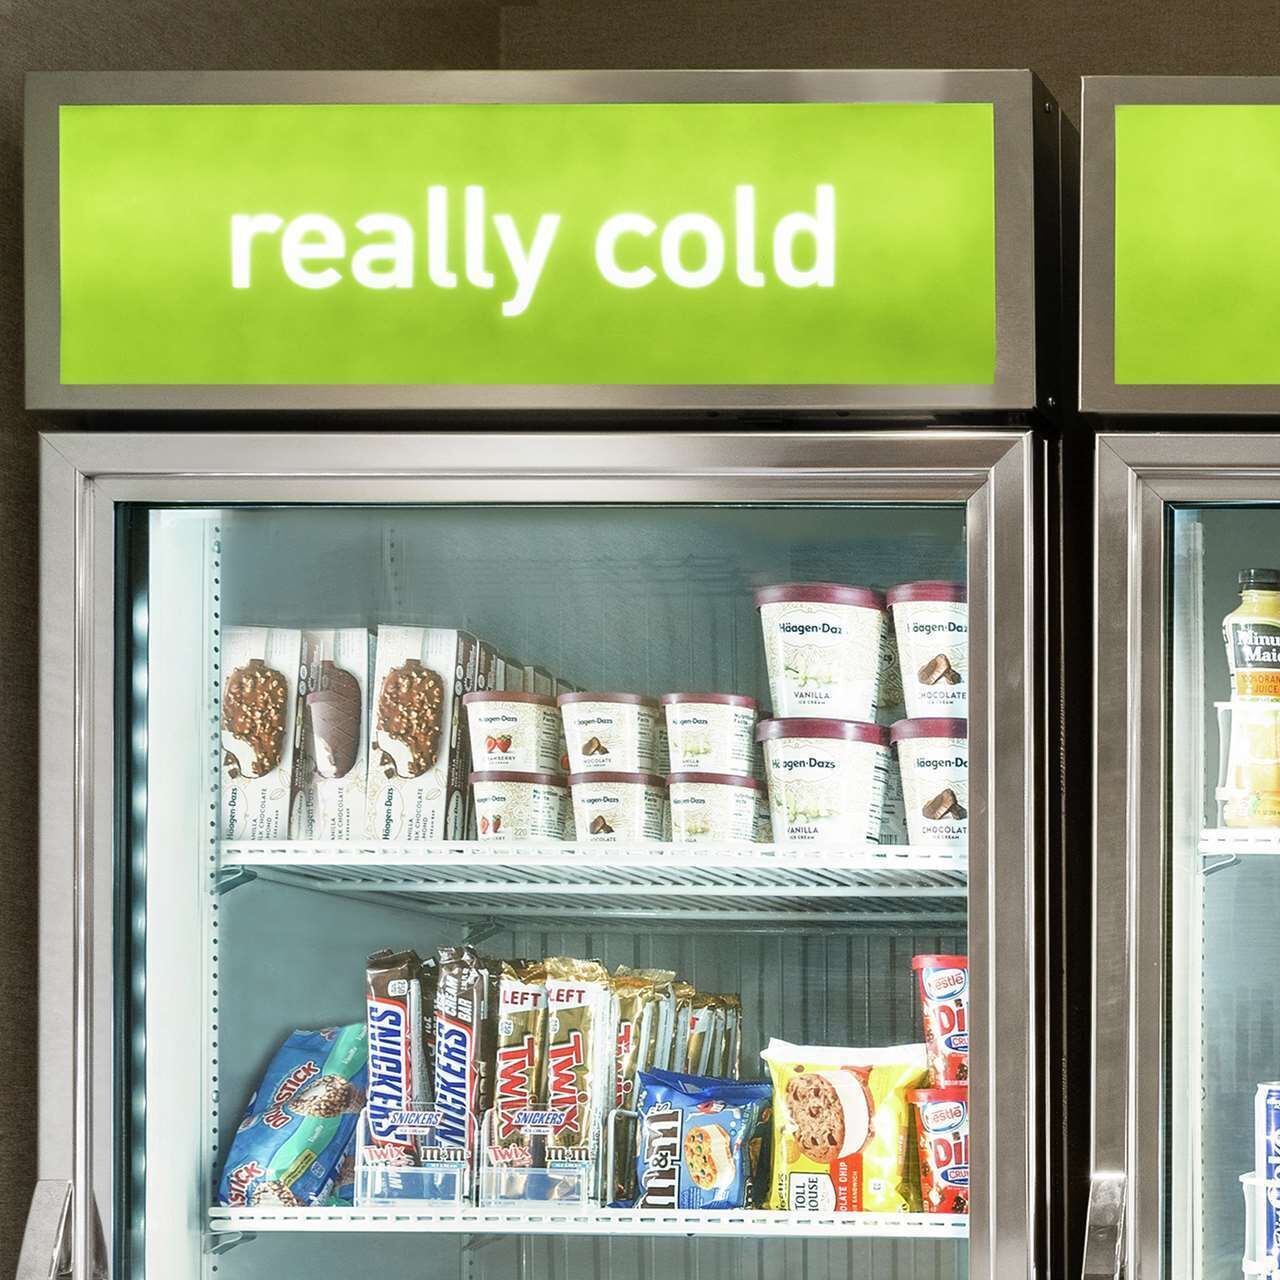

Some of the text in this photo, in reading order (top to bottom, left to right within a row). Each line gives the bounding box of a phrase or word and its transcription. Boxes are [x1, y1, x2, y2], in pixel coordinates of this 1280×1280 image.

[228, 186, 837, 314] really cold
[502, 990, 542, 1006] LEFT
[457, 999, 473, 1022] BAR
[390, 1112, 441, 1125] SNICKERS
[515, 1112, 566, 1125] SNICKERS
[796, 1183, 805, 1209] TOLL
